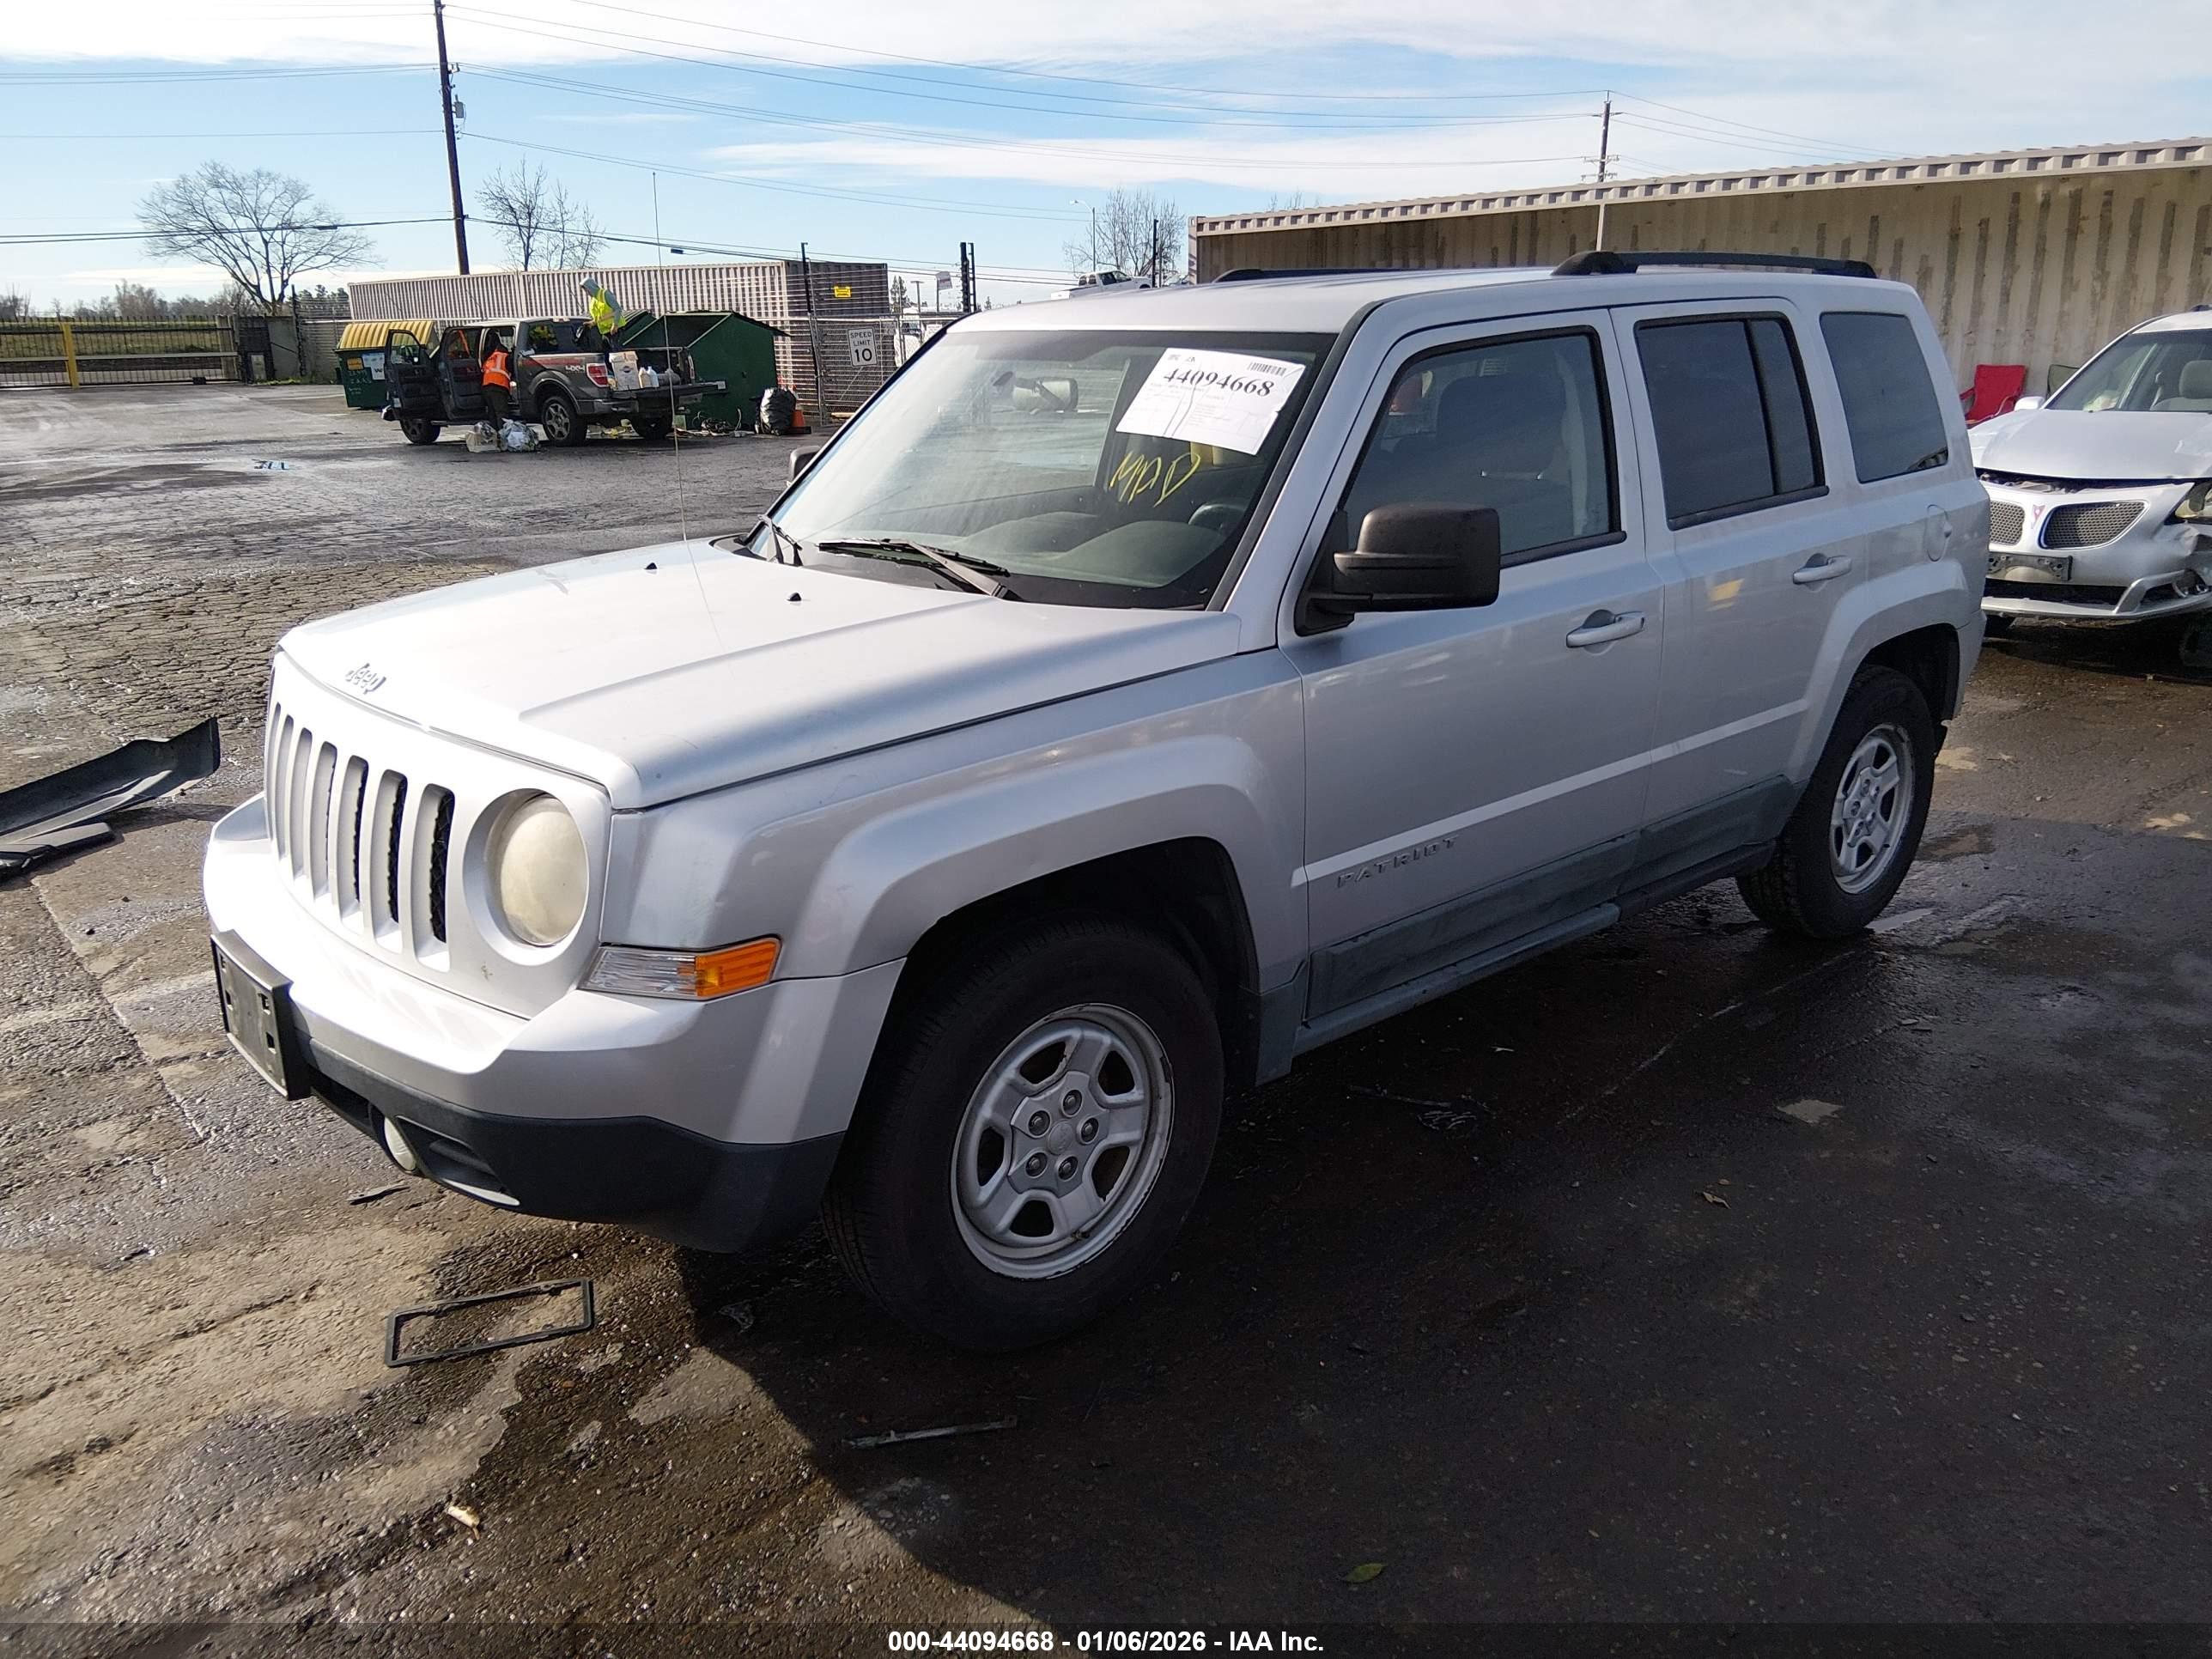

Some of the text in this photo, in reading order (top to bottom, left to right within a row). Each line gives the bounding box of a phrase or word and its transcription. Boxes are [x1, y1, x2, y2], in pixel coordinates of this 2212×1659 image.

[854, 348, 872, 362] 10
[1164, 368, 1275, 398] 44094668
[345, 662, 387, 695] Jeep
[1336, 835, 1459, 889] PATRIOT
